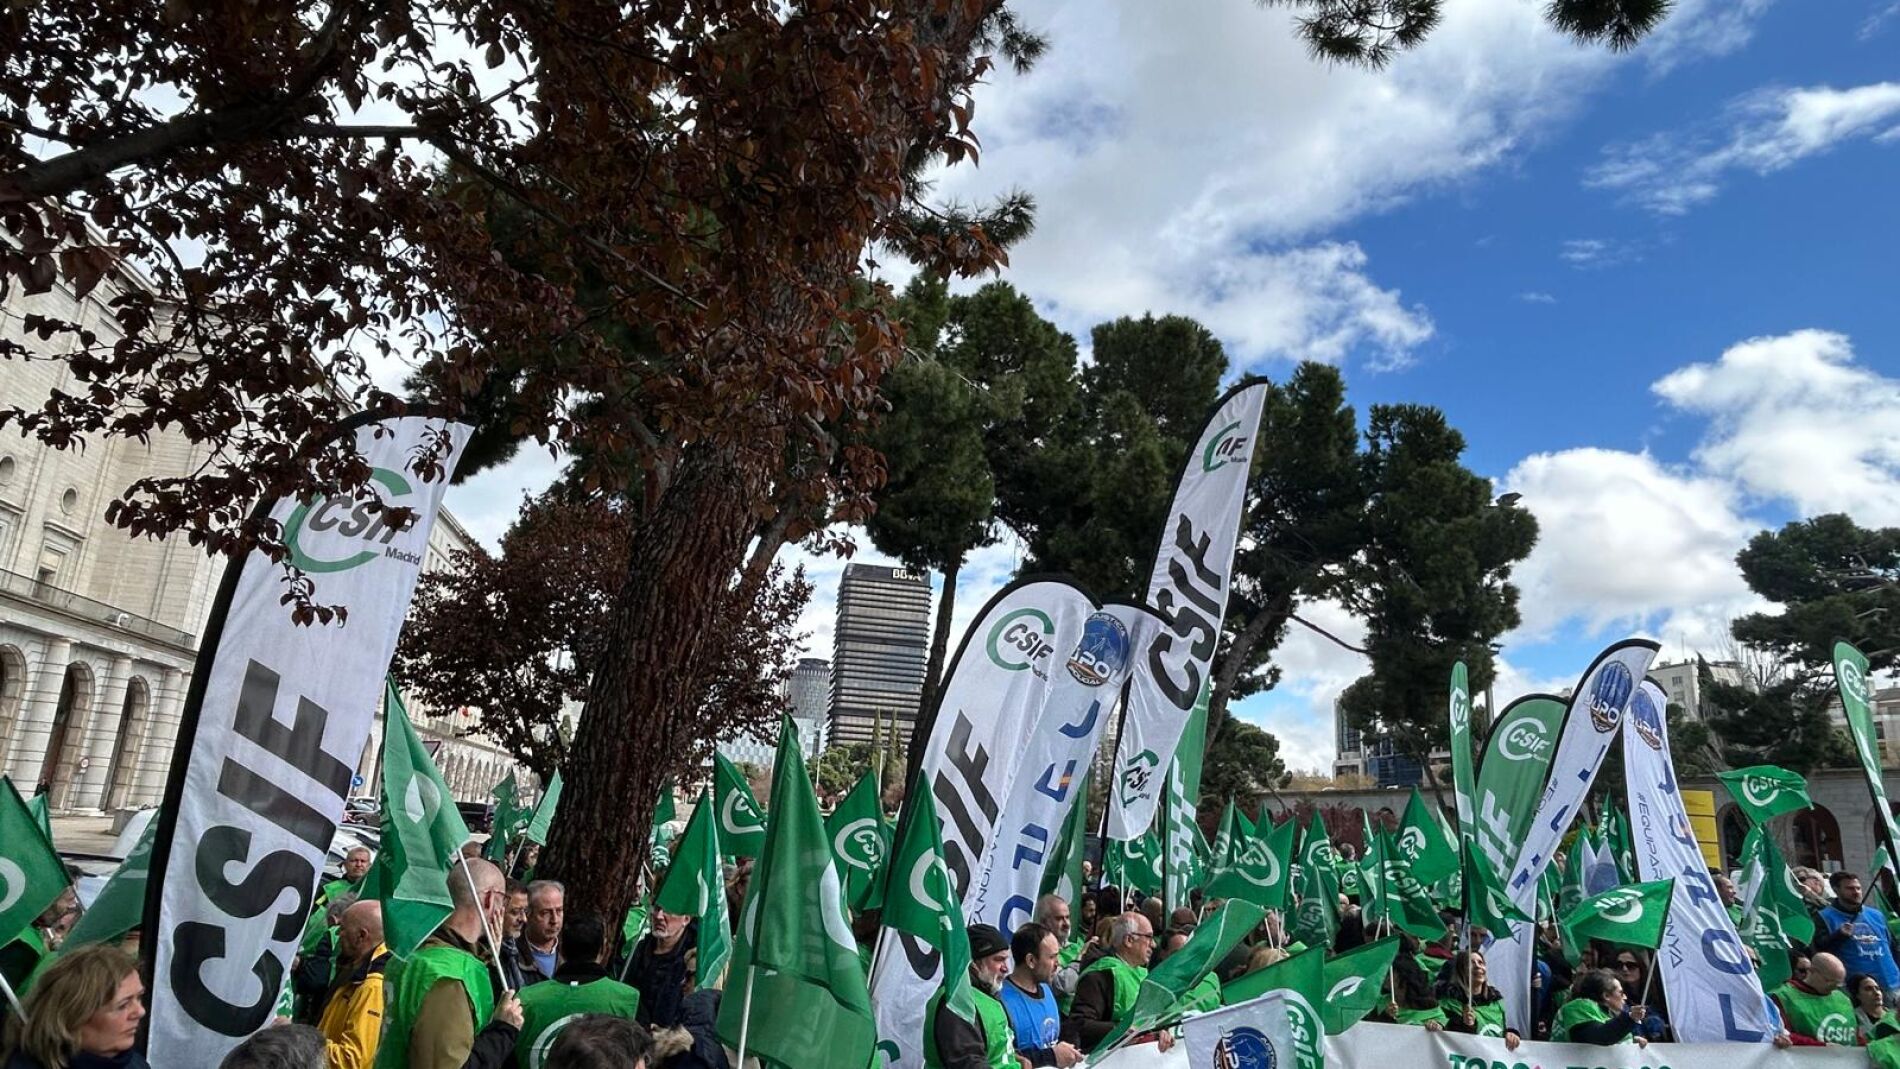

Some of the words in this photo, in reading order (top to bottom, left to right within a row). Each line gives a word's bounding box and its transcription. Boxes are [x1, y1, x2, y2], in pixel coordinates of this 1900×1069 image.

[385, 547, 421, 566] Madrid
[1147, 512, 1222, 711] CSIF
[1003, 623, 1055, 661] CSIF
[1508, 727, 1550, 757] CSIF
[171, 658, 353, 1038] CSIF
[1826, 1022, 1857, 1042] CSIF
